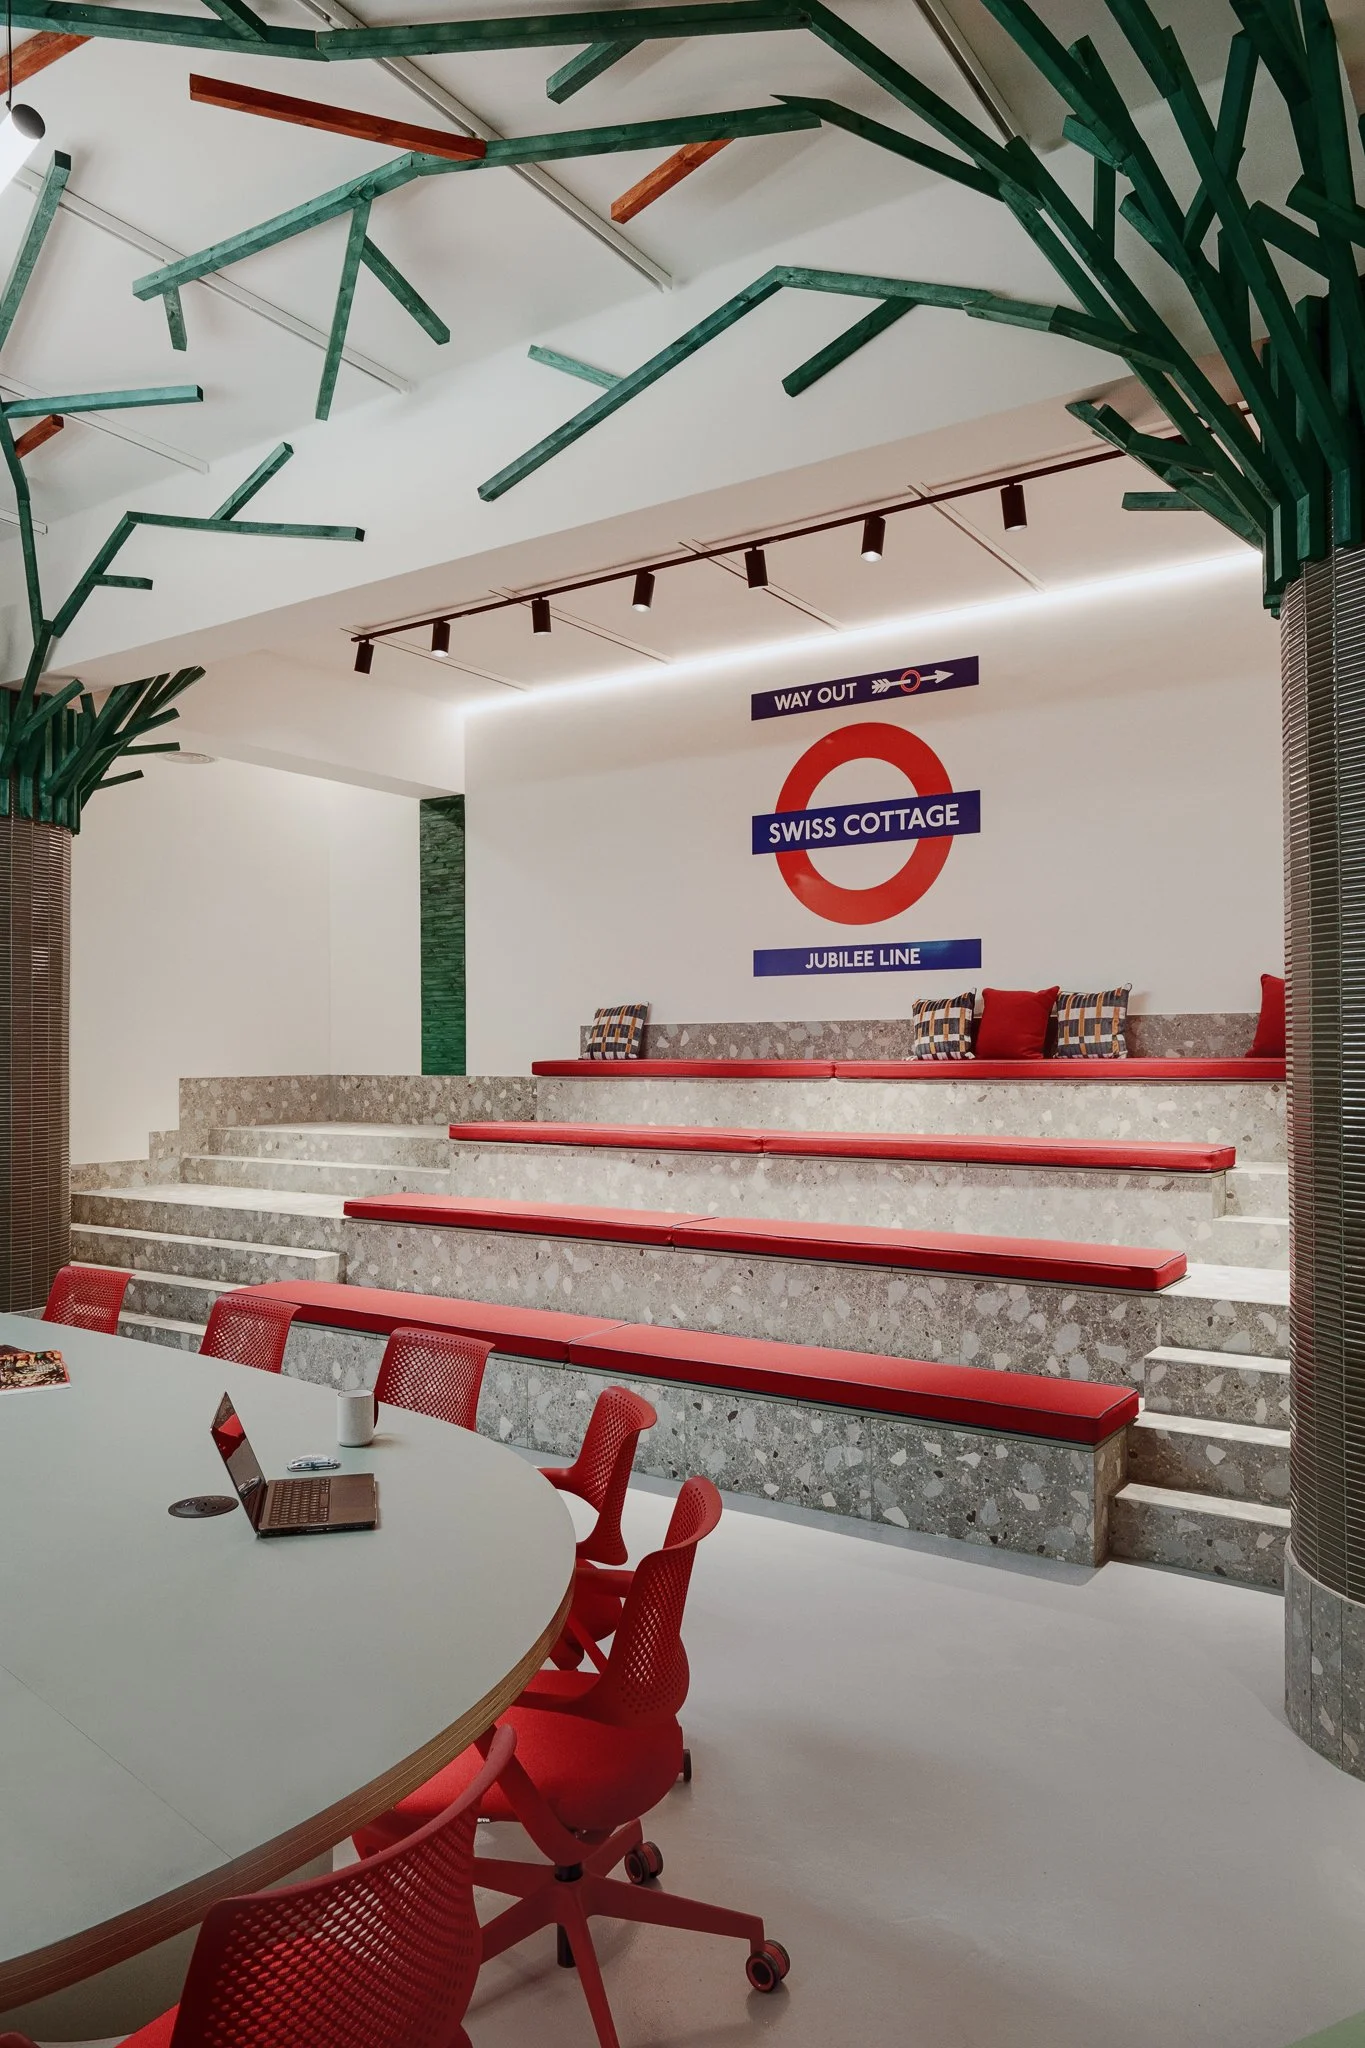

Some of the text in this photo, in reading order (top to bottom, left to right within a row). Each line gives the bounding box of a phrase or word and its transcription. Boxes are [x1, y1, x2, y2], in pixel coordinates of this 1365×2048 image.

[774, 683, 857, 711] WAY OUT
[769, 804, 960, 843] SWISS COTTAGE
[805, 948, 921, 969] JUBILEE LINE
